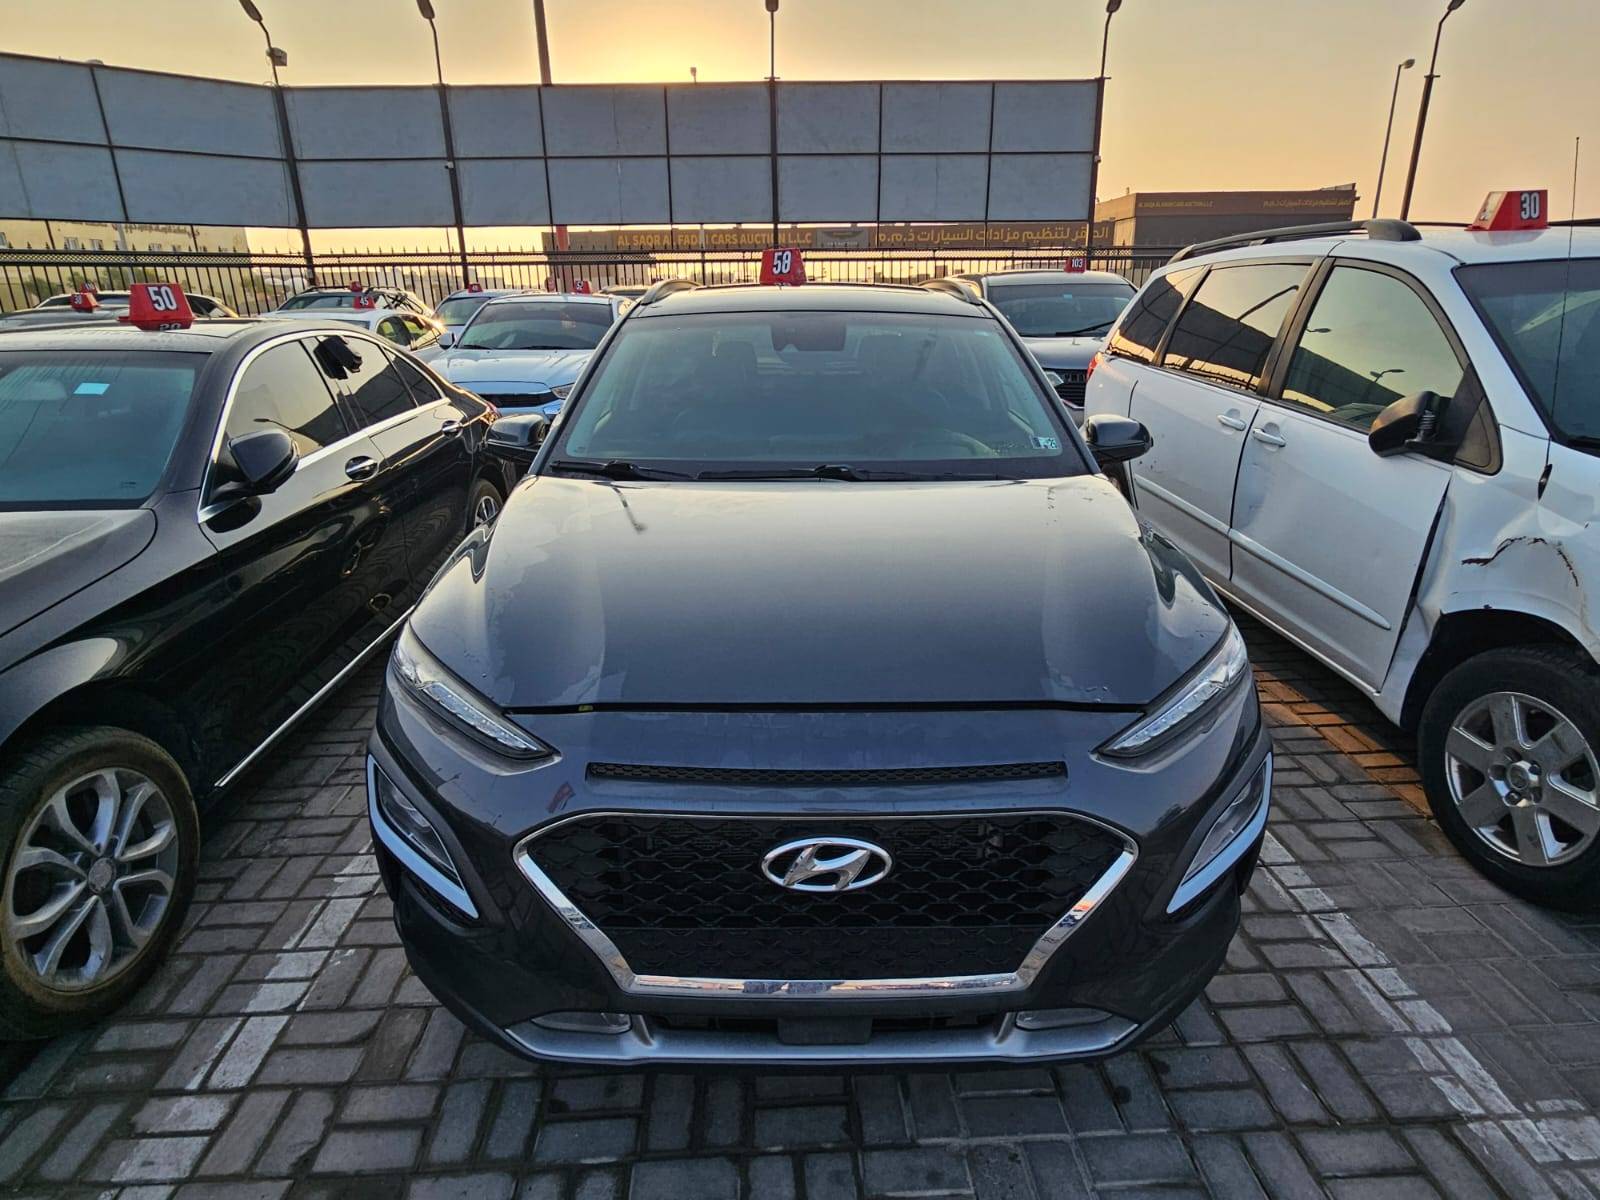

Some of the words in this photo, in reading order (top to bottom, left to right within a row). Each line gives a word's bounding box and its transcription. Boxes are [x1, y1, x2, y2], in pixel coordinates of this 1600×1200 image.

[1520, 192, 1540, 219] 30
[633, 235, 660, 246] SAQR
[679, 234, 708, 246] FADI
[711, 233, 738, 244] CARS
[740, 233, 786, 244] AUCTIN
[917, 228, 973, 244] السيارات
[1022, 226, 1070, 243] لتنظيم
[772, 250, 792, 275] 58
[147, 286, 178, 311] 50
